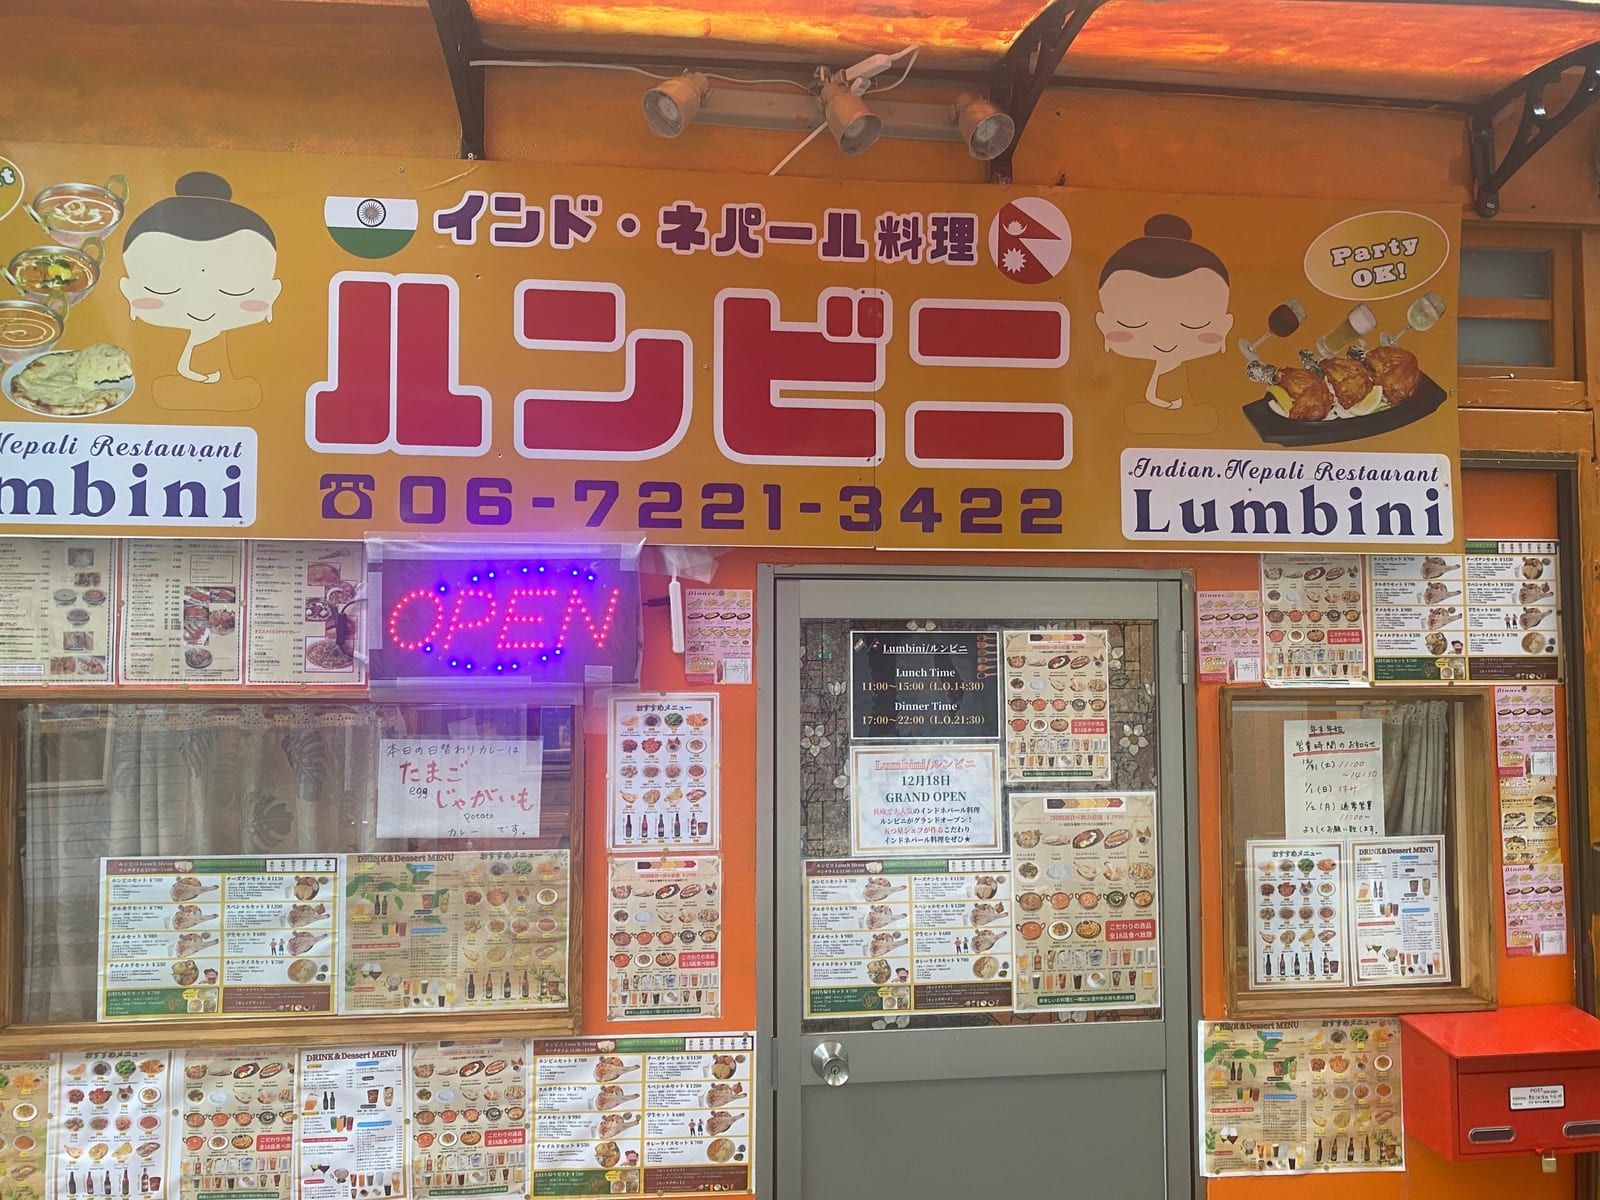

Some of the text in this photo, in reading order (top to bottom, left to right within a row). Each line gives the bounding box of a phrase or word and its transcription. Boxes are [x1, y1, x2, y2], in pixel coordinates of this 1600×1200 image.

[433, 190, 978, 266] インド・ネパール料理
[1330, 235, 1420, 267] Party
[1351, 262, 1407, 288] OK!
[305, 270, 1073, 470] ルンビニ
[90, 434, 243, 459] Restaurant
[1313, 460, 1439, 483] Restaurant
[399, 475, 1063, 534] 06-7221-3422
[1133, 484, 1444, 537] Lumbini
[389, 588, 621, 650] OPEN
[882, 644, 968, 654] Lumbini/ルンビニ
[896, 668, 956, 678] Lunch Time
[862, 682, 924, 691] 11:00～15:00
[894, 702, 958, 712] Dinner Time
[862, 716, 924, 725] 17:00～22:00
[386, 743, 519, 756] 本日の日替わりカレーは
[1296, 741, 1376, 752] 営業時間のお知らせ
[399, 760, 468, 785] たまご
[902, 775, 950, 786] 12月18日
[409, 786, 428, 799] egg
[885, 791, 967, 803] GRAND OPEN
[436, 787, 534, 811] じゃがいも
[448, 828, 478, 837] カレー
[428, 853, 454, 862] MENU
[480, 852, 543, 860] おすすめメニュー
[1276, 1021, 1299, 1029] MENU
[1322, 1019, 1378, 1027] おすすめメニュー
[306, 1050, 398, 1062] DRINK&Dessert MENU
